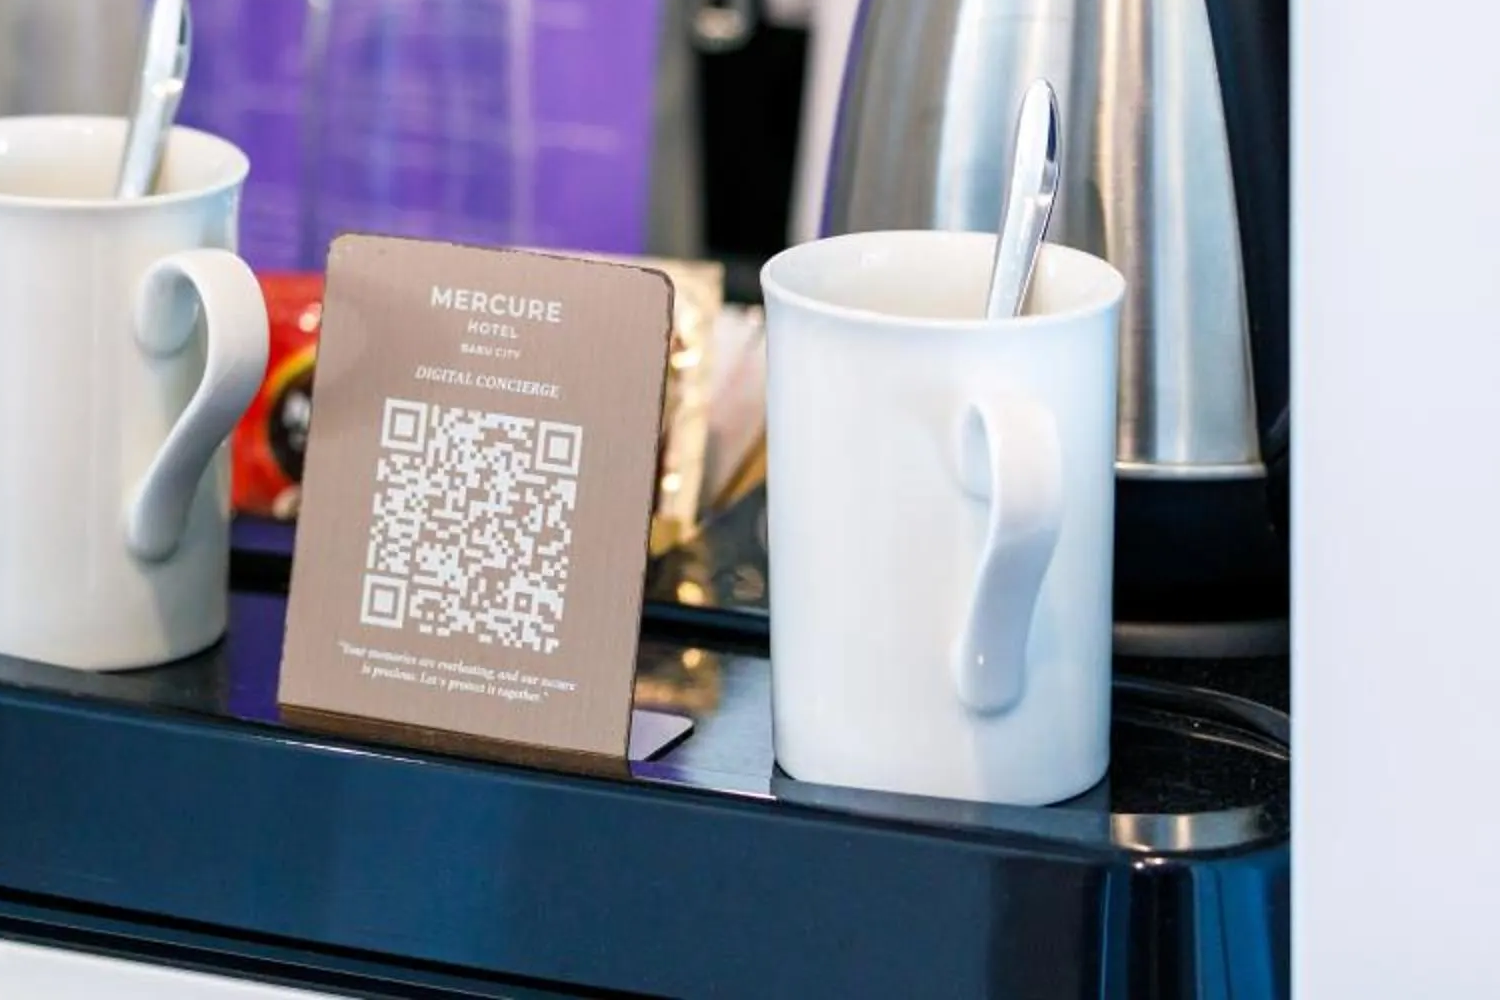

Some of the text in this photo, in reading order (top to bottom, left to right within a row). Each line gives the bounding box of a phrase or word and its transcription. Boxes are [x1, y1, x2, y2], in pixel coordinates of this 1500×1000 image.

[431, 285, 563, 323] MERCURE
[467, 318, 520, 339] HOTEL
[460, 343, 521, 360] BAKU CITY
[414, 364, 562, 398] DIGITAL CONCIERGE
[498, 669, 520, 683] and
